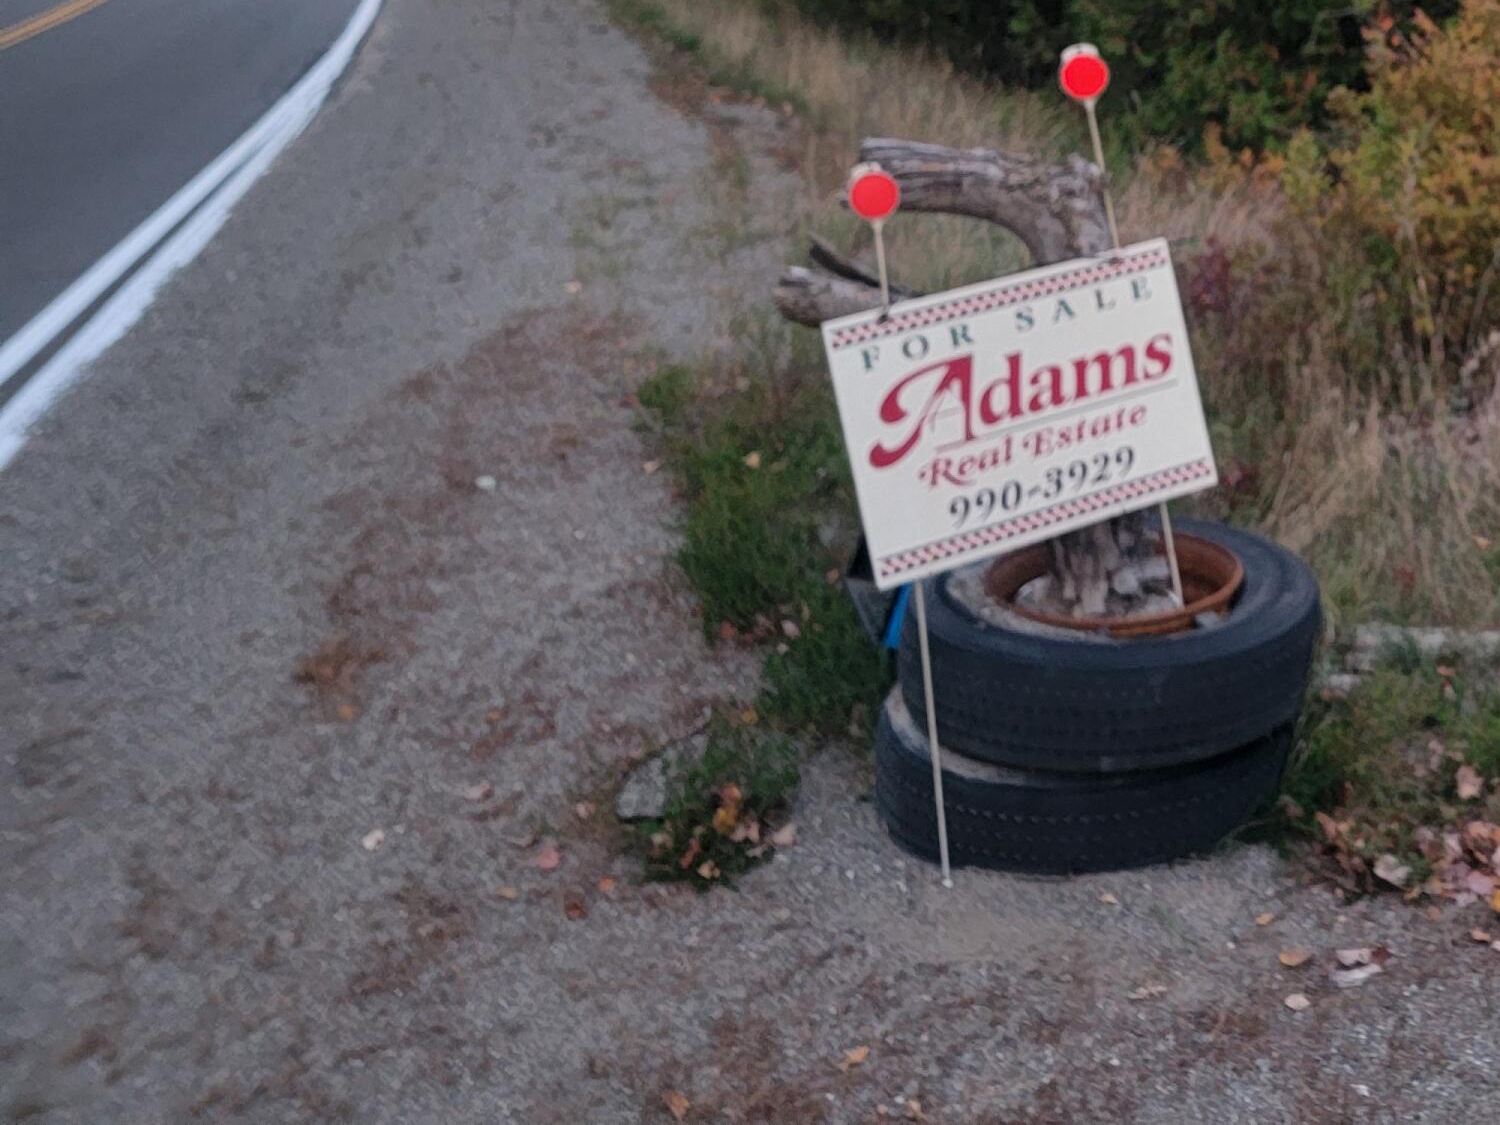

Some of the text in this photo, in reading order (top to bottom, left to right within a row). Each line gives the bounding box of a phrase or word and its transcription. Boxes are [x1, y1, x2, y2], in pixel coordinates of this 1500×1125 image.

[860, 276, 1153, 373] FOR SALE
[868, 332, 1174, 469] Adams
[917, 404, 1147, 491] Real Estate
[948, 444, 1136, 529] 990-3929
